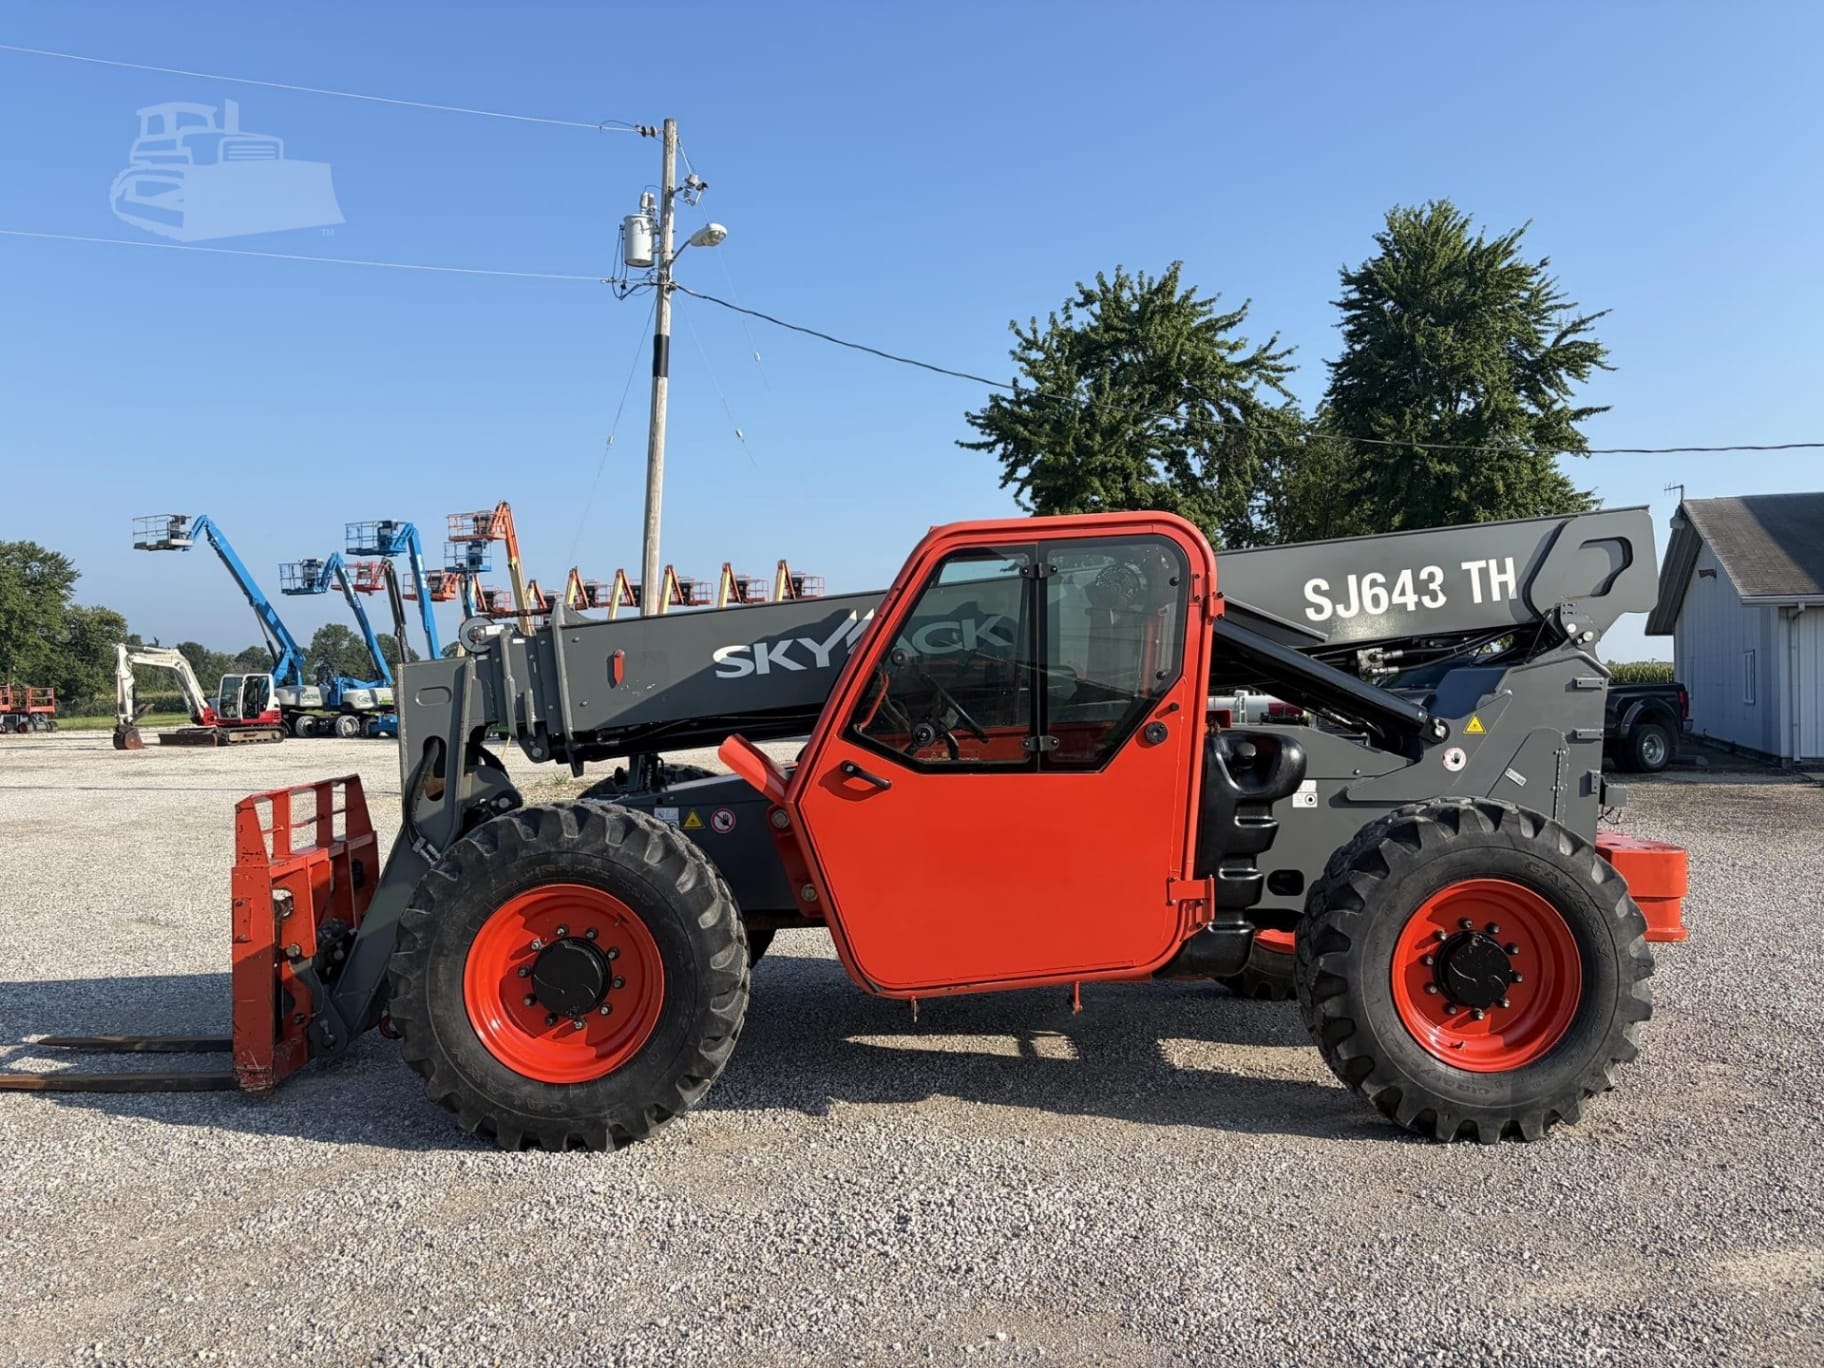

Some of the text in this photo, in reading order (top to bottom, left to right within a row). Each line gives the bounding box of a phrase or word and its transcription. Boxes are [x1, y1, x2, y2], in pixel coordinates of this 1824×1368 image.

[1303, 557, 1518, 622] SJ643 TH
[712, 608, 1015, 679] SKYCK
